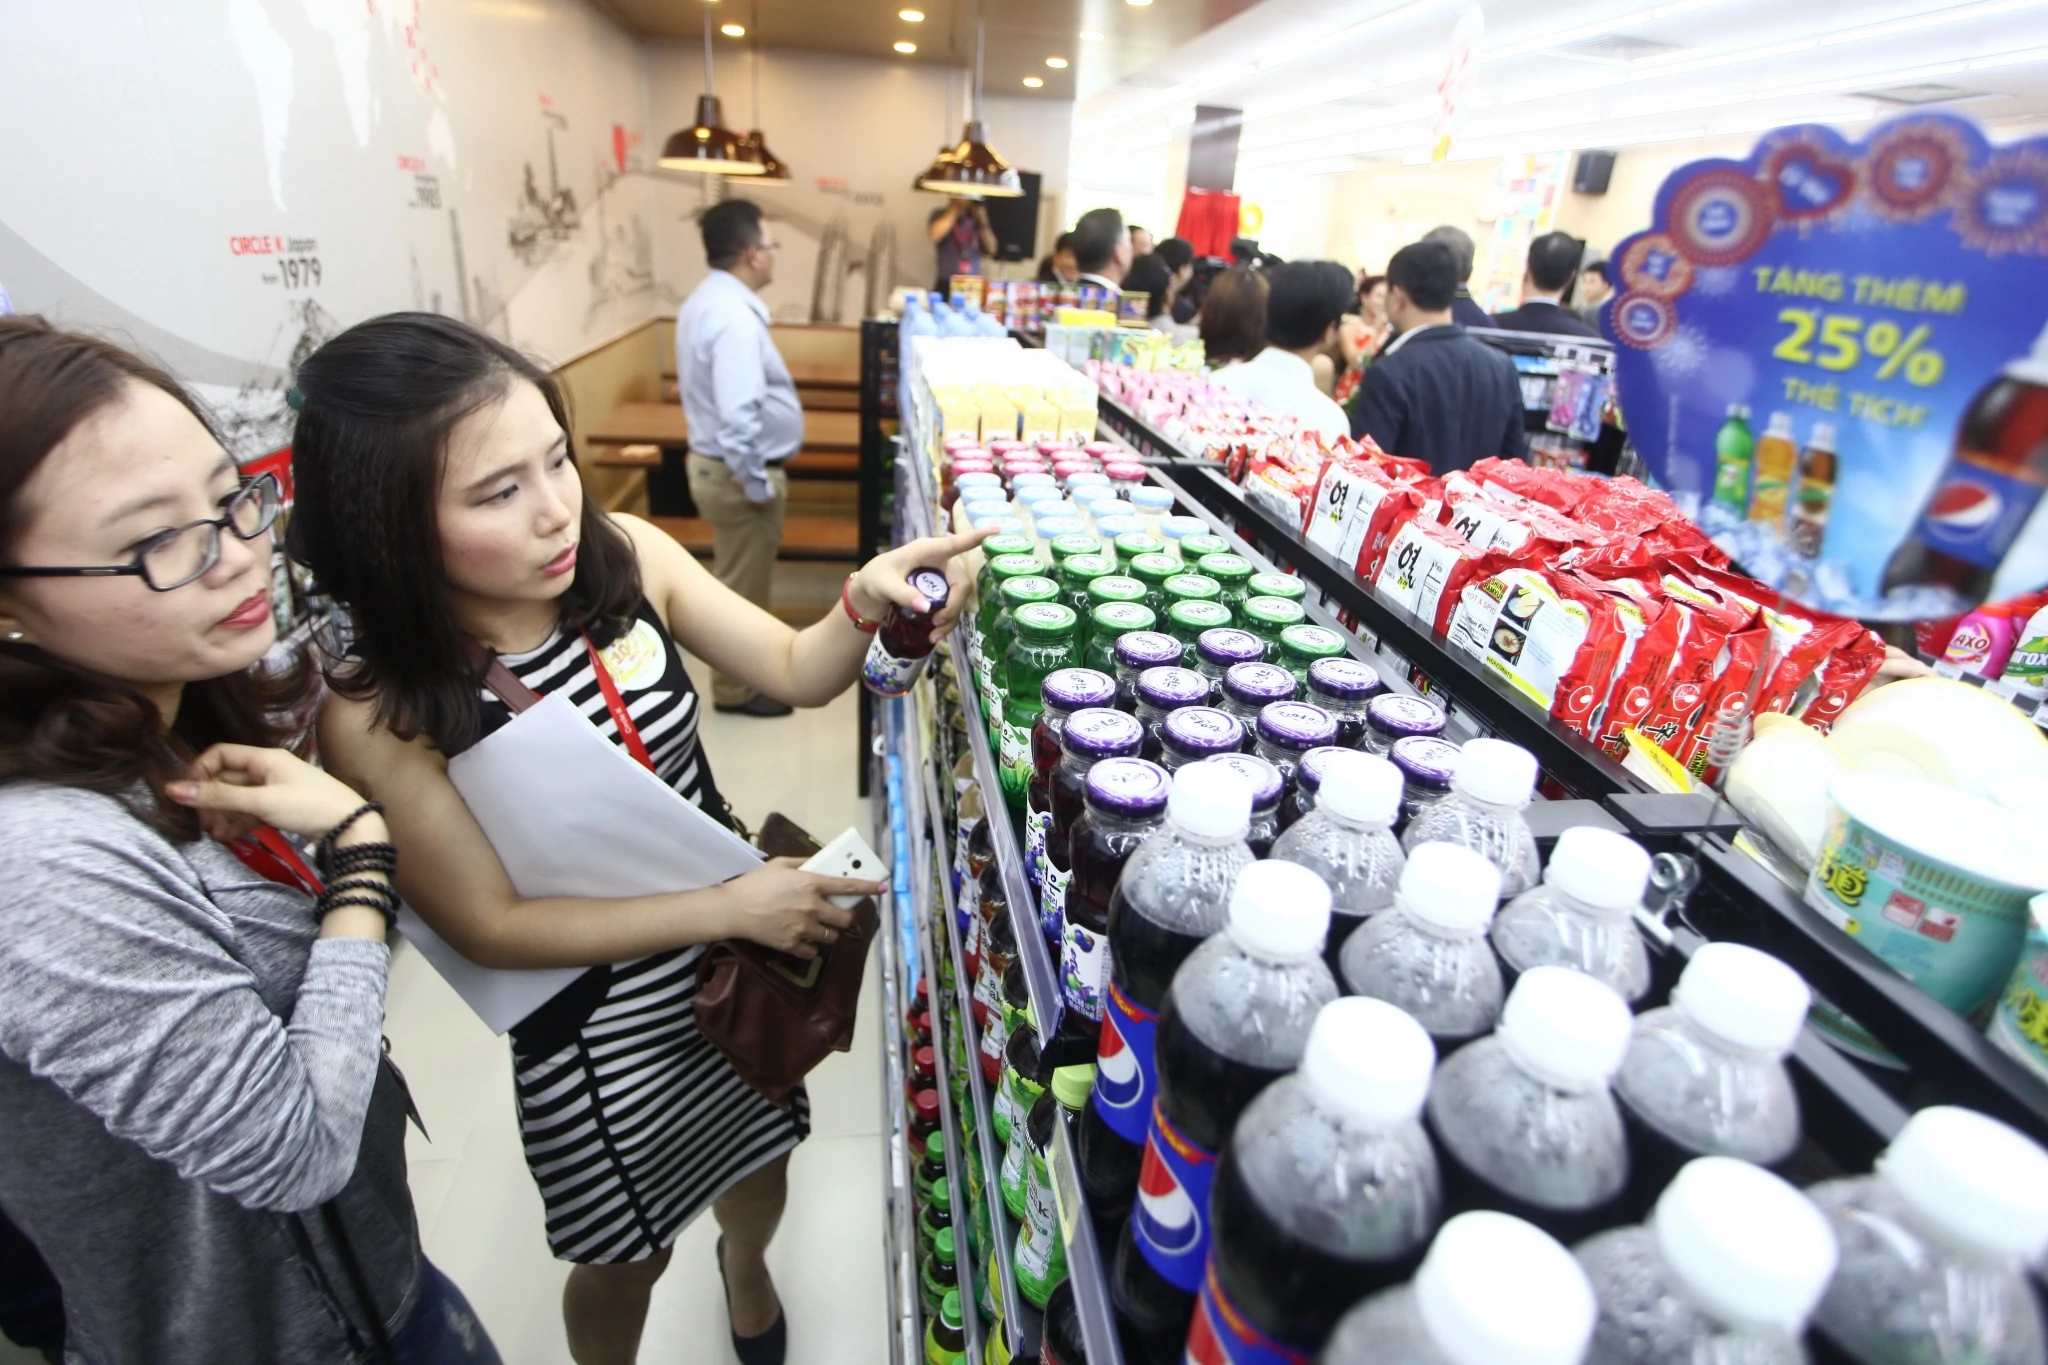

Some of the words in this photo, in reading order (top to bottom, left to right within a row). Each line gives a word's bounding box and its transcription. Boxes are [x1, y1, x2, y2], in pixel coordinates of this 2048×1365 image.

[229, 235, 273, 256] CIRCLE
[274, 235, 285, 253] K
[278, 257, 322, 290] 1979
[1771, 307, 1945, 386] 25%
[1491, 578, 1504, 591] SHIN
[1466, 591, 1478, 601] HOT
[1483, 601, 1497, 615] SPIC
[1953, 633, 1988, 650] AXO
[614, 706, 623, 715] K
[618, 713, 633, 735] Circle
[1025, 1121, 1036, 1150] IRIN
